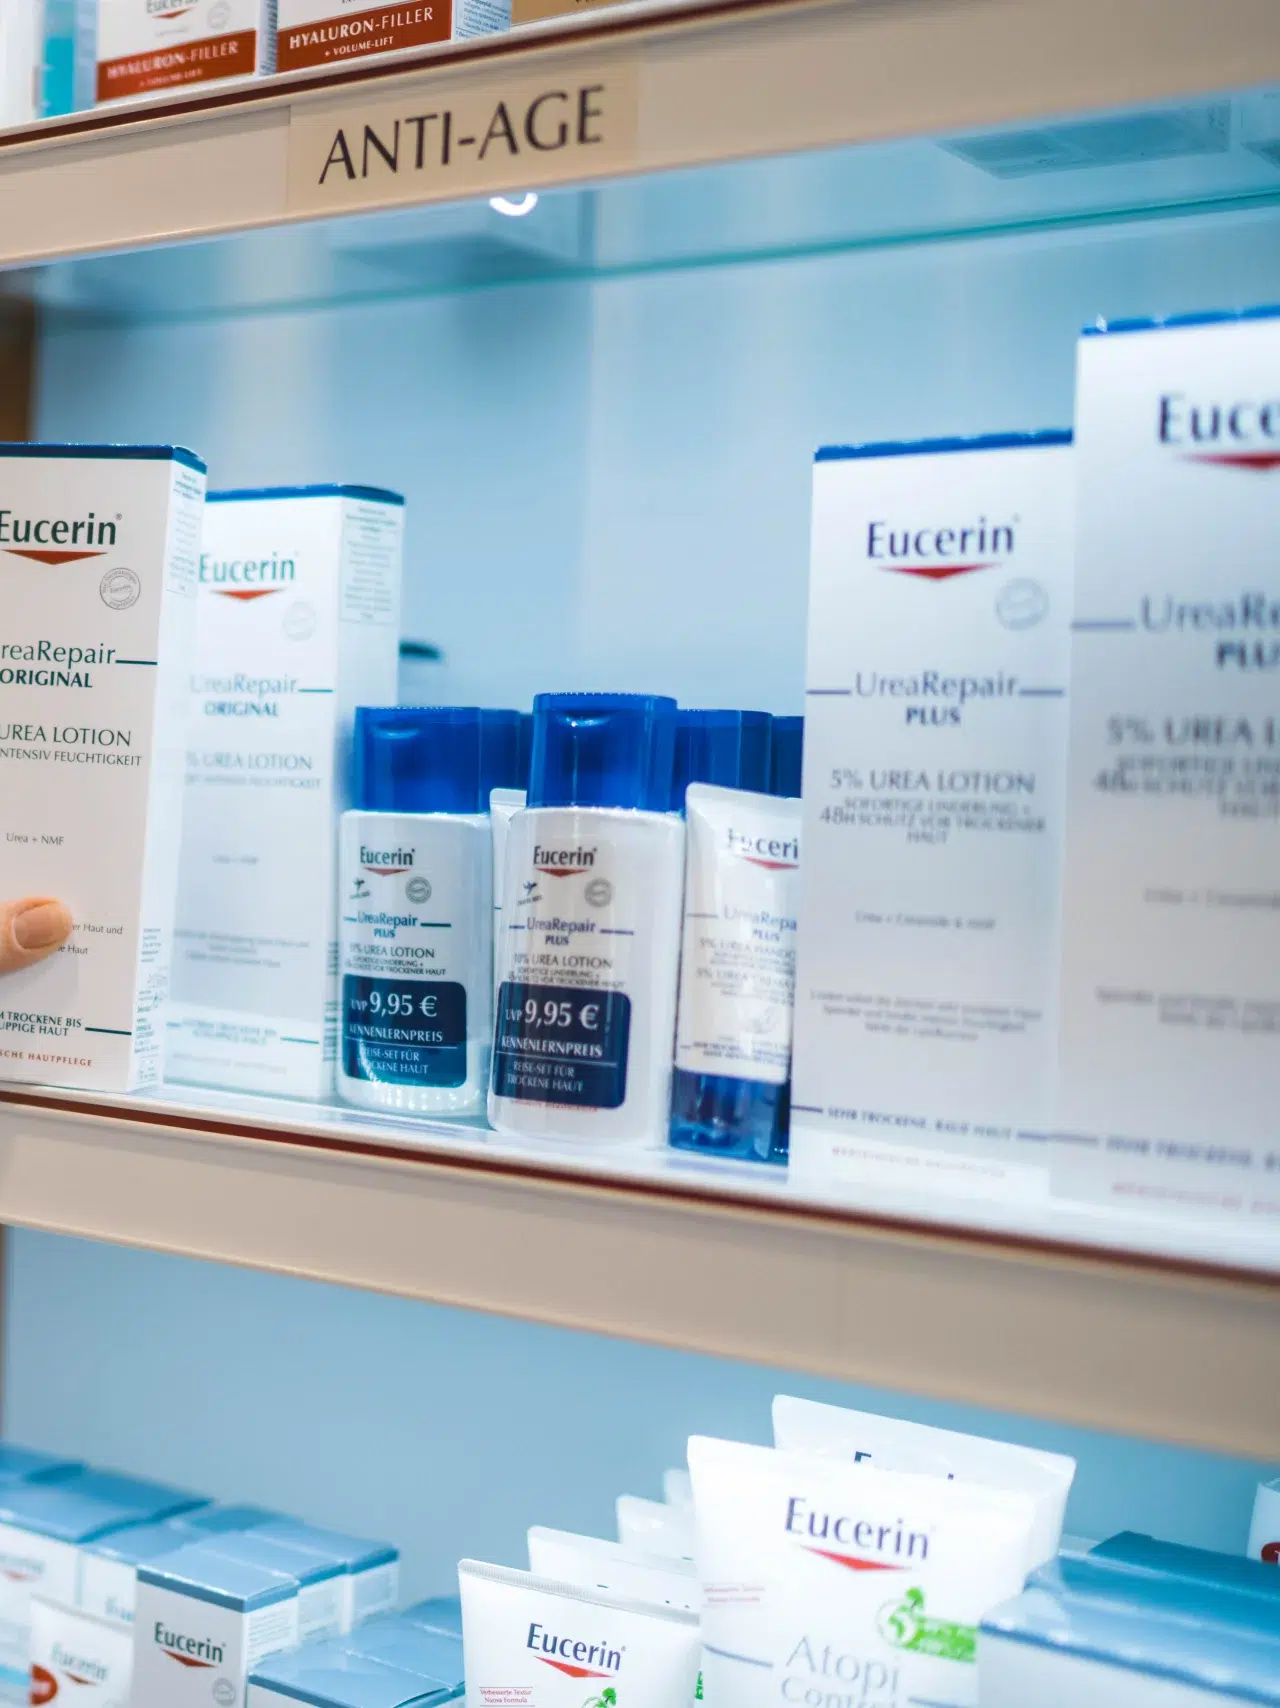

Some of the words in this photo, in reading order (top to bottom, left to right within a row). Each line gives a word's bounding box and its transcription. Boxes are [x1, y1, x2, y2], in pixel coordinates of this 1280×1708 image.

[289, 6, 434, 49] HYALURON-FILLER
[333, 36, 394, 56] VOLUME-LIFT
[318, 85, 605, 185] ANTI-AGE
[866, 515, 1015, 559] Eucerin
[198, 551, 296, 583] Eucerin
[855, 669, 1019, 704] UreaRepair
[204, 700, 279, 717] ORIGINAL
[905, 705, 963, 727] PLUS
[53, 726, 133, 747] LOTION
[54, 750, 143, 767] FEUCHTIGKEIT
[247, 752, 313, 770] LOTION
[869, 769, 930, 792] UREA
[937, 770, 1037, 794] LOTION
[6, 833, 28, 843] Urea
[41, 835, 65, 845] NMF
[728, 827, 799, 859] Euceri
[359, 846, 414, 866] Eucerin
[533, 845, 595, 866] Eucerin
[83, 923, 104, 934] Haut
[106, 925, 123, 935] und
[358, 912, 418, 928] UreaRepair
[527, 917, 596, 935] UreaRepair
[374, 928, 396, 938] PLUS
[545, 935, 569, 945] PLUS
[67, 945, 88, 955] Haut
[390, 946, 436, 959] LOTION
[532, 954, 558, 966] UREA
[562, 956, 613, 969] LOTION
[426, 968, 446, 976] HAUT
[351, 999, 368, 1011] UVP
[369, 991, 413, 1017] 9,95
[419, 995, 438, 1017] €
[7, 1011, 62, 1026] TROCKENE
[65, 1017, 82, 1028] BIS
[505, 1008, 523, 1021] UVP
[525, 998, 572, 1028] 9,95
[578, 1004, 600, 1030] €
[38, 1025, 69, 1037] HAUT
[401, 1049, 420, 1062] FÜR
[501, 1035, 603, 1058] KENNENLERNPREIS
[28, 1052, 93, 1067] HAUTPFLEGE
[400, 1063, 429, 1075] HAUT
[513, 1061, 552, 1075] REISE-SET
[507, 1073, 549, 1089] TROCKENE
[552, 1079, 584, 1092] HAUT
[785, 1496, 929, 1560] Eucerin
[153, 1621, 224, 1663] Eucerin
[526, 1622, 622, 1671] Eucerin
[785, 1635, 900, 1697] Atopi
